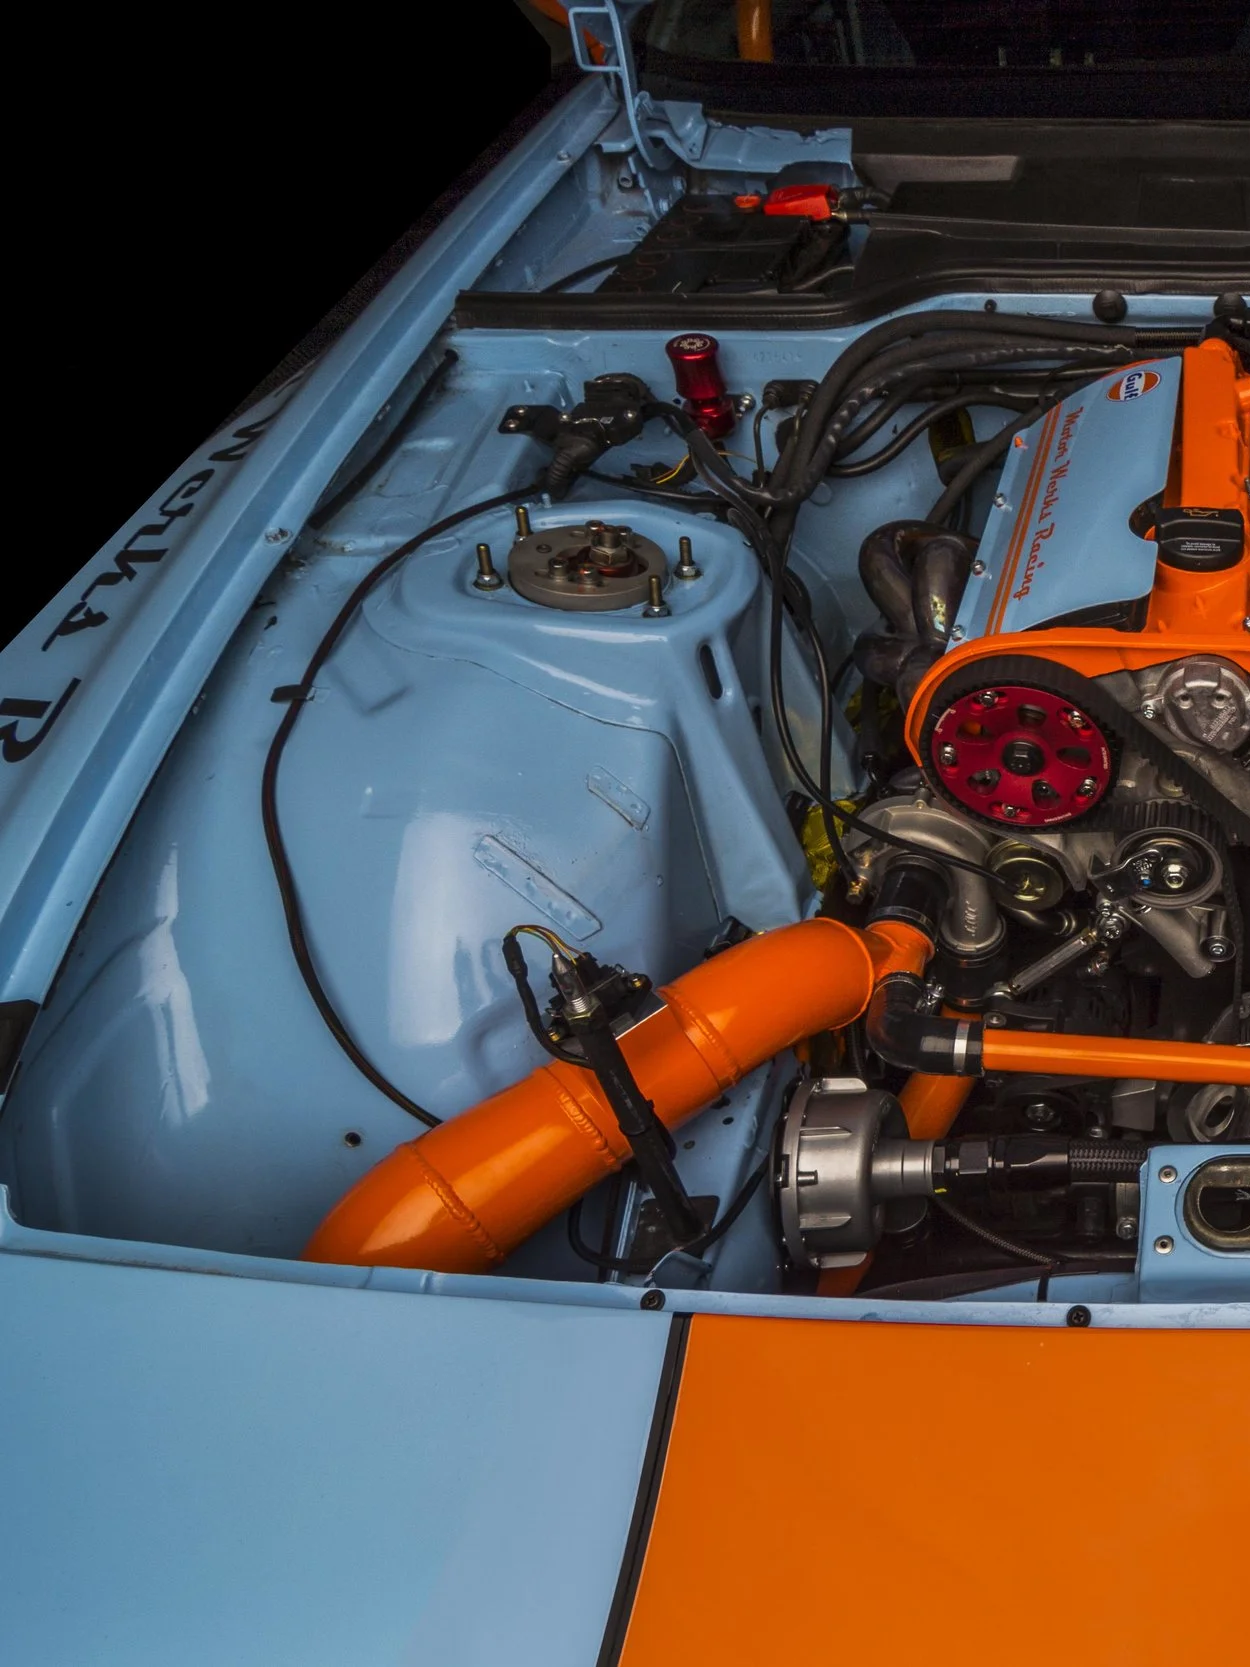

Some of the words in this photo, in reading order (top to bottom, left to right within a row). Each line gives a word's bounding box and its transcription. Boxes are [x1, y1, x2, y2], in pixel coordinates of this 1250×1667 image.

[1124, 372, 1142, 400] Gulf
[1054, 406, 1084, 463] Motor
[42, 392, 291, 651] Werks
[1013, 523, 1055, 600] Racing
